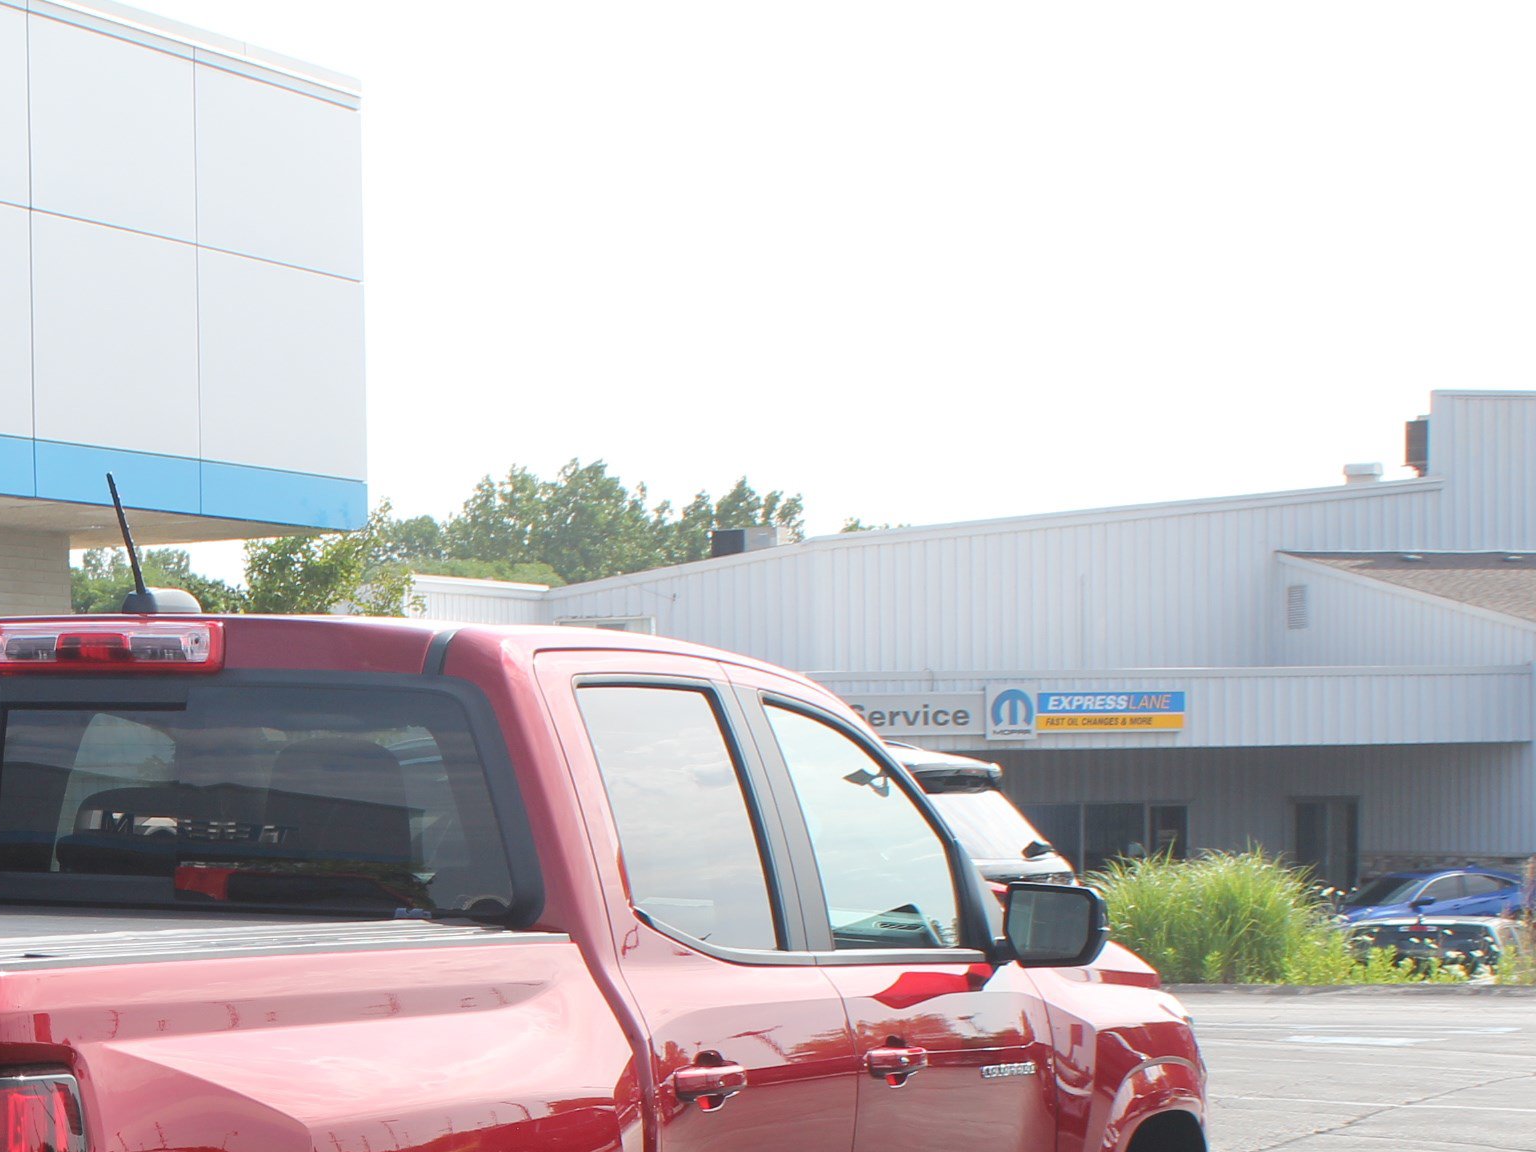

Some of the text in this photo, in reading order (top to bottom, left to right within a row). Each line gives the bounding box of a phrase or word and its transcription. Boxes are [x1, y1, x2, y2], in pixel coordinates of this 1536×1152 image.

[1045, 716, 1153, 727] FAST OIL CHANGES & MORE
